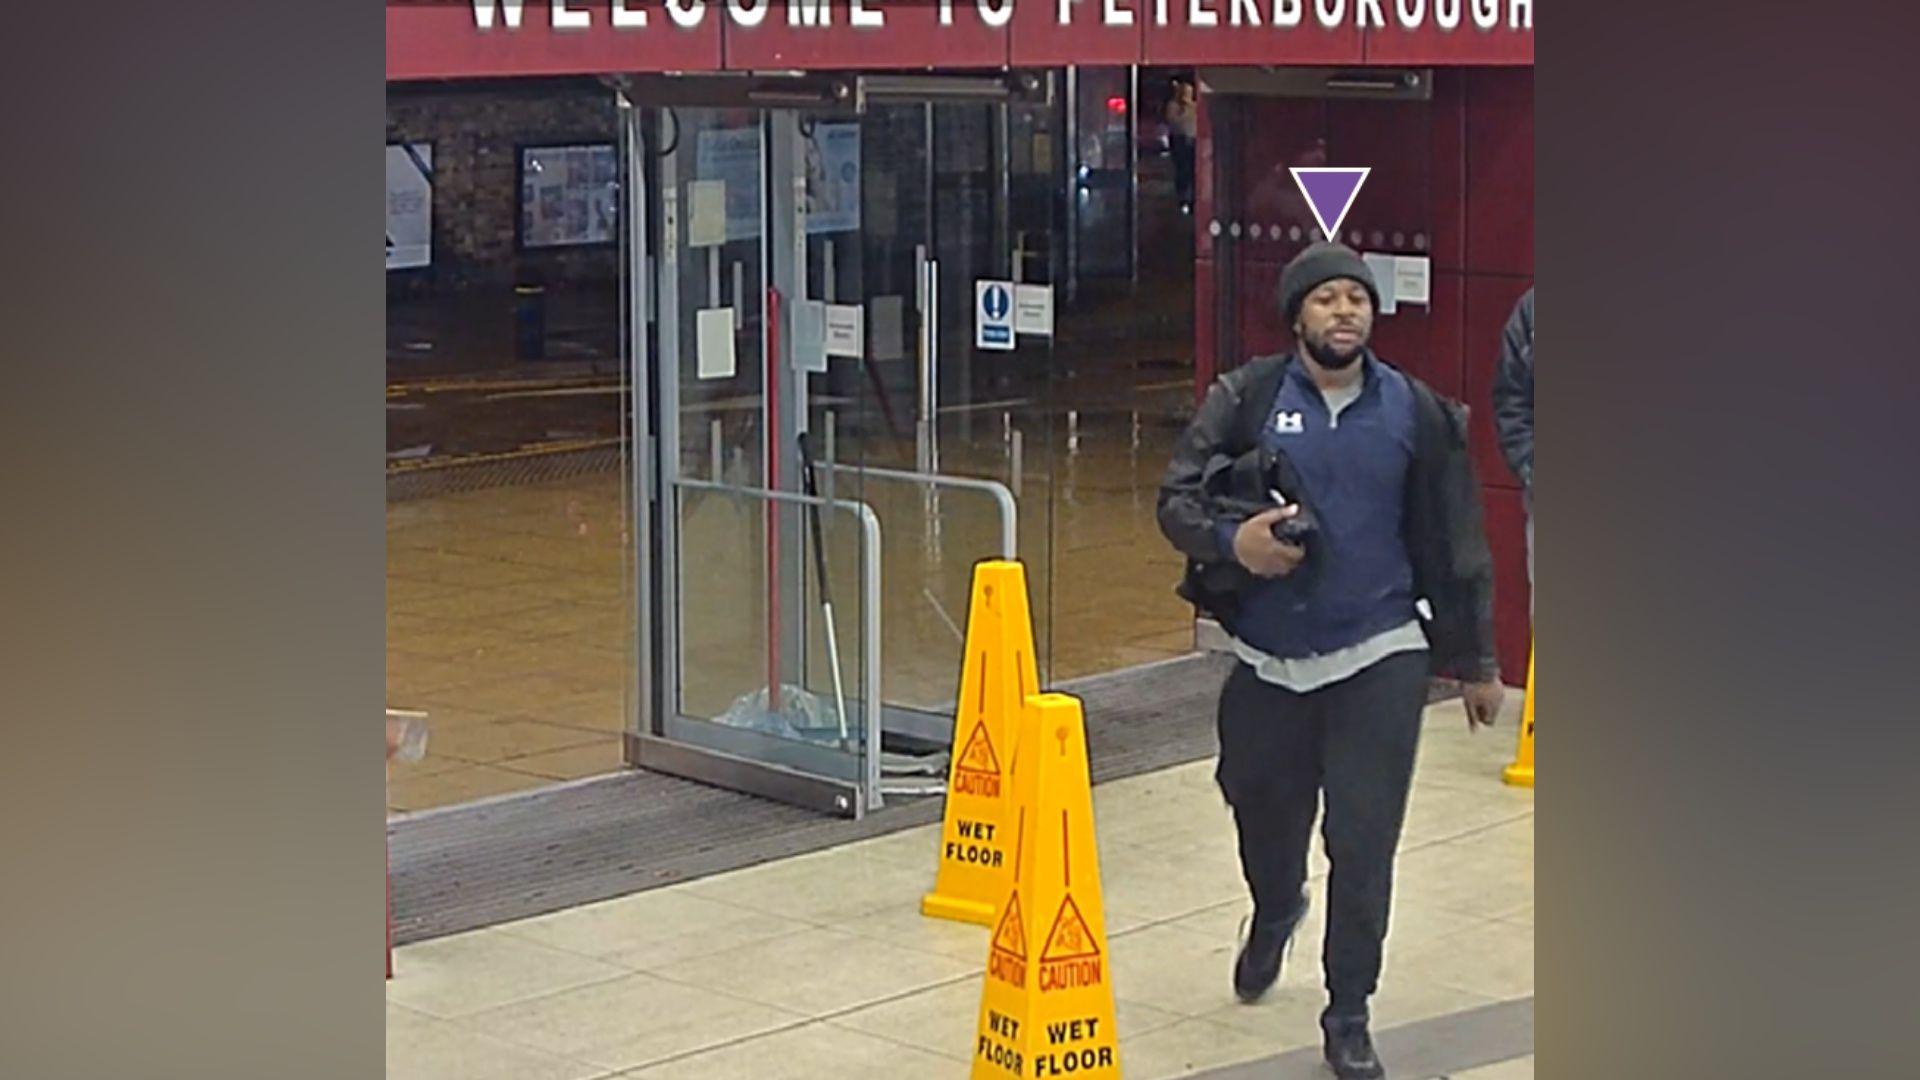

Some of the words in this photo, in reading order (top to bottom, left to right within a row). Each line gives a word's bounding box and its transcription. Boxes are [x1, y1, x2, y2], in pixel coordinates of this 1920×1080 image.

[954, 772, 1000, 798] CAUTION
[957, 820, 996, 842] WET
[946, 842, 1003, 868] FLOOR
[1039, 960, 1101, 993] CAUTION
[989, 1010, 1019, 1040] WET
[1047, 1017, 1099, 1045] WET
[978, 1035, 1023, 1077] FLOOR
[1035, 1046, 1113, 1078] FLOOR
